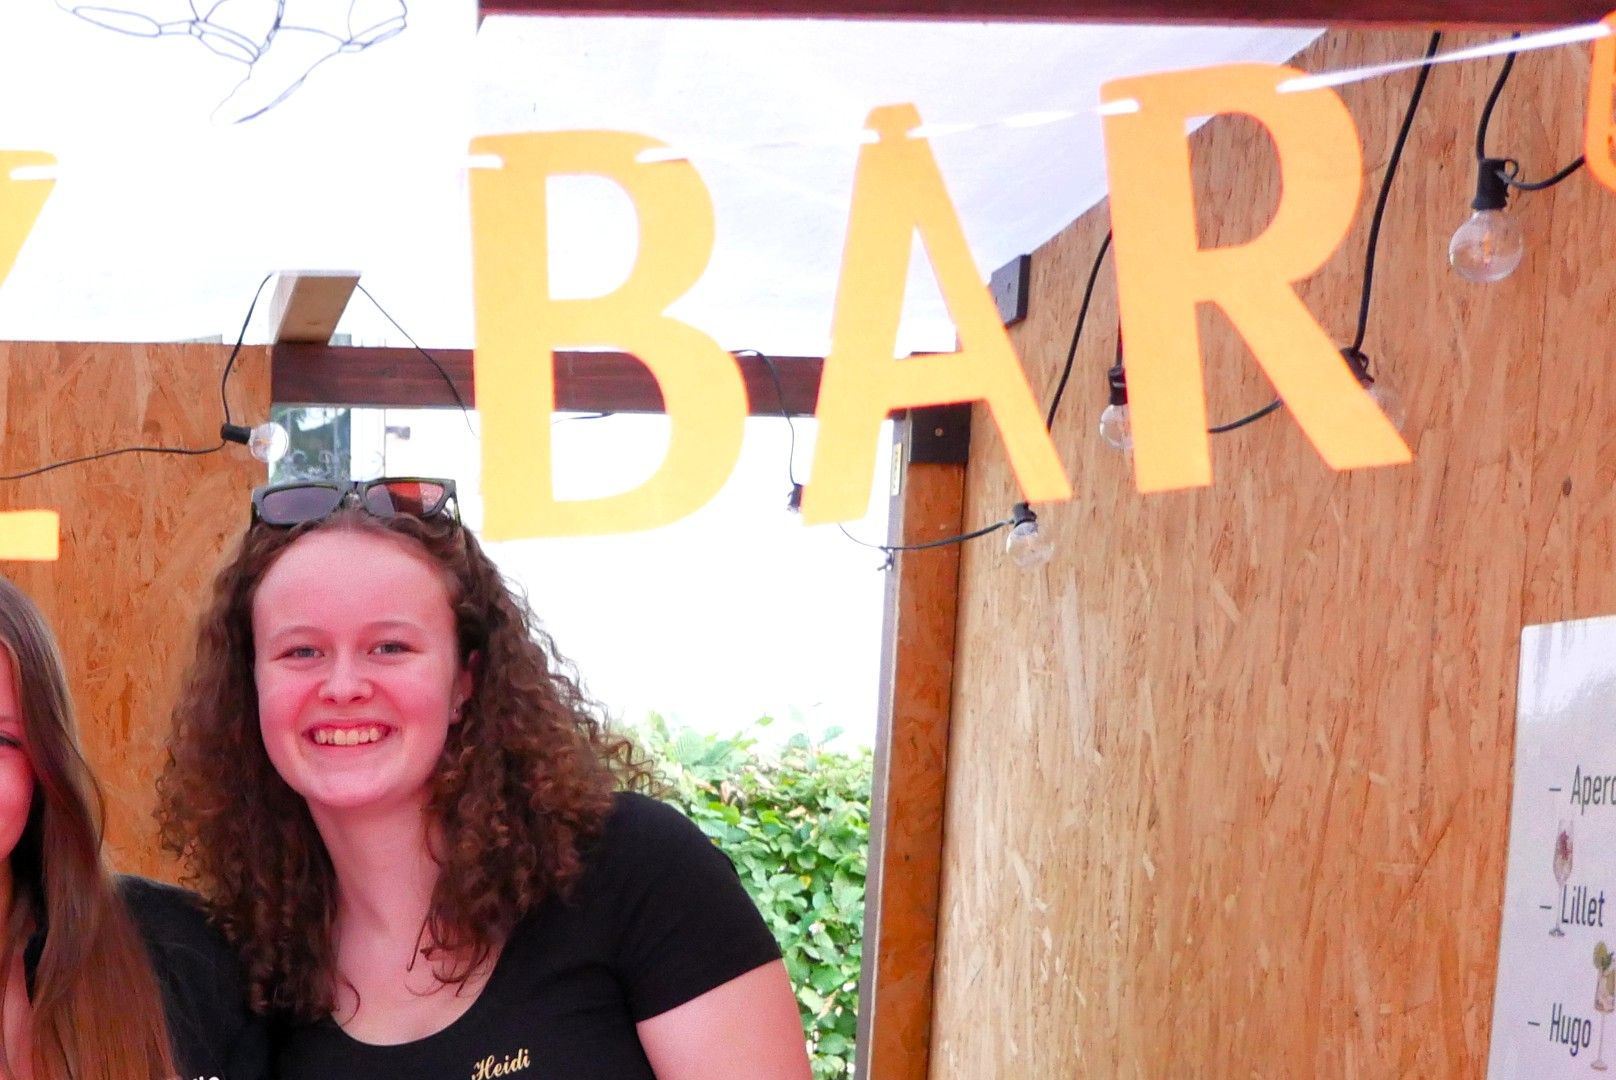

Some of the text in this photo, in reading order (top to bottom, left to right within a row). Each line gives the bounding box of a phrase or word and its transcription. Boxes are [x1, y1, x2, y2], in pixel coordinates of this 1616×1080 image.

[469, 61, 1413, 543] BAR
[1561, 884, 1606, 928] Lillet
[1549, 1002, 1592, 1057] Hugo
